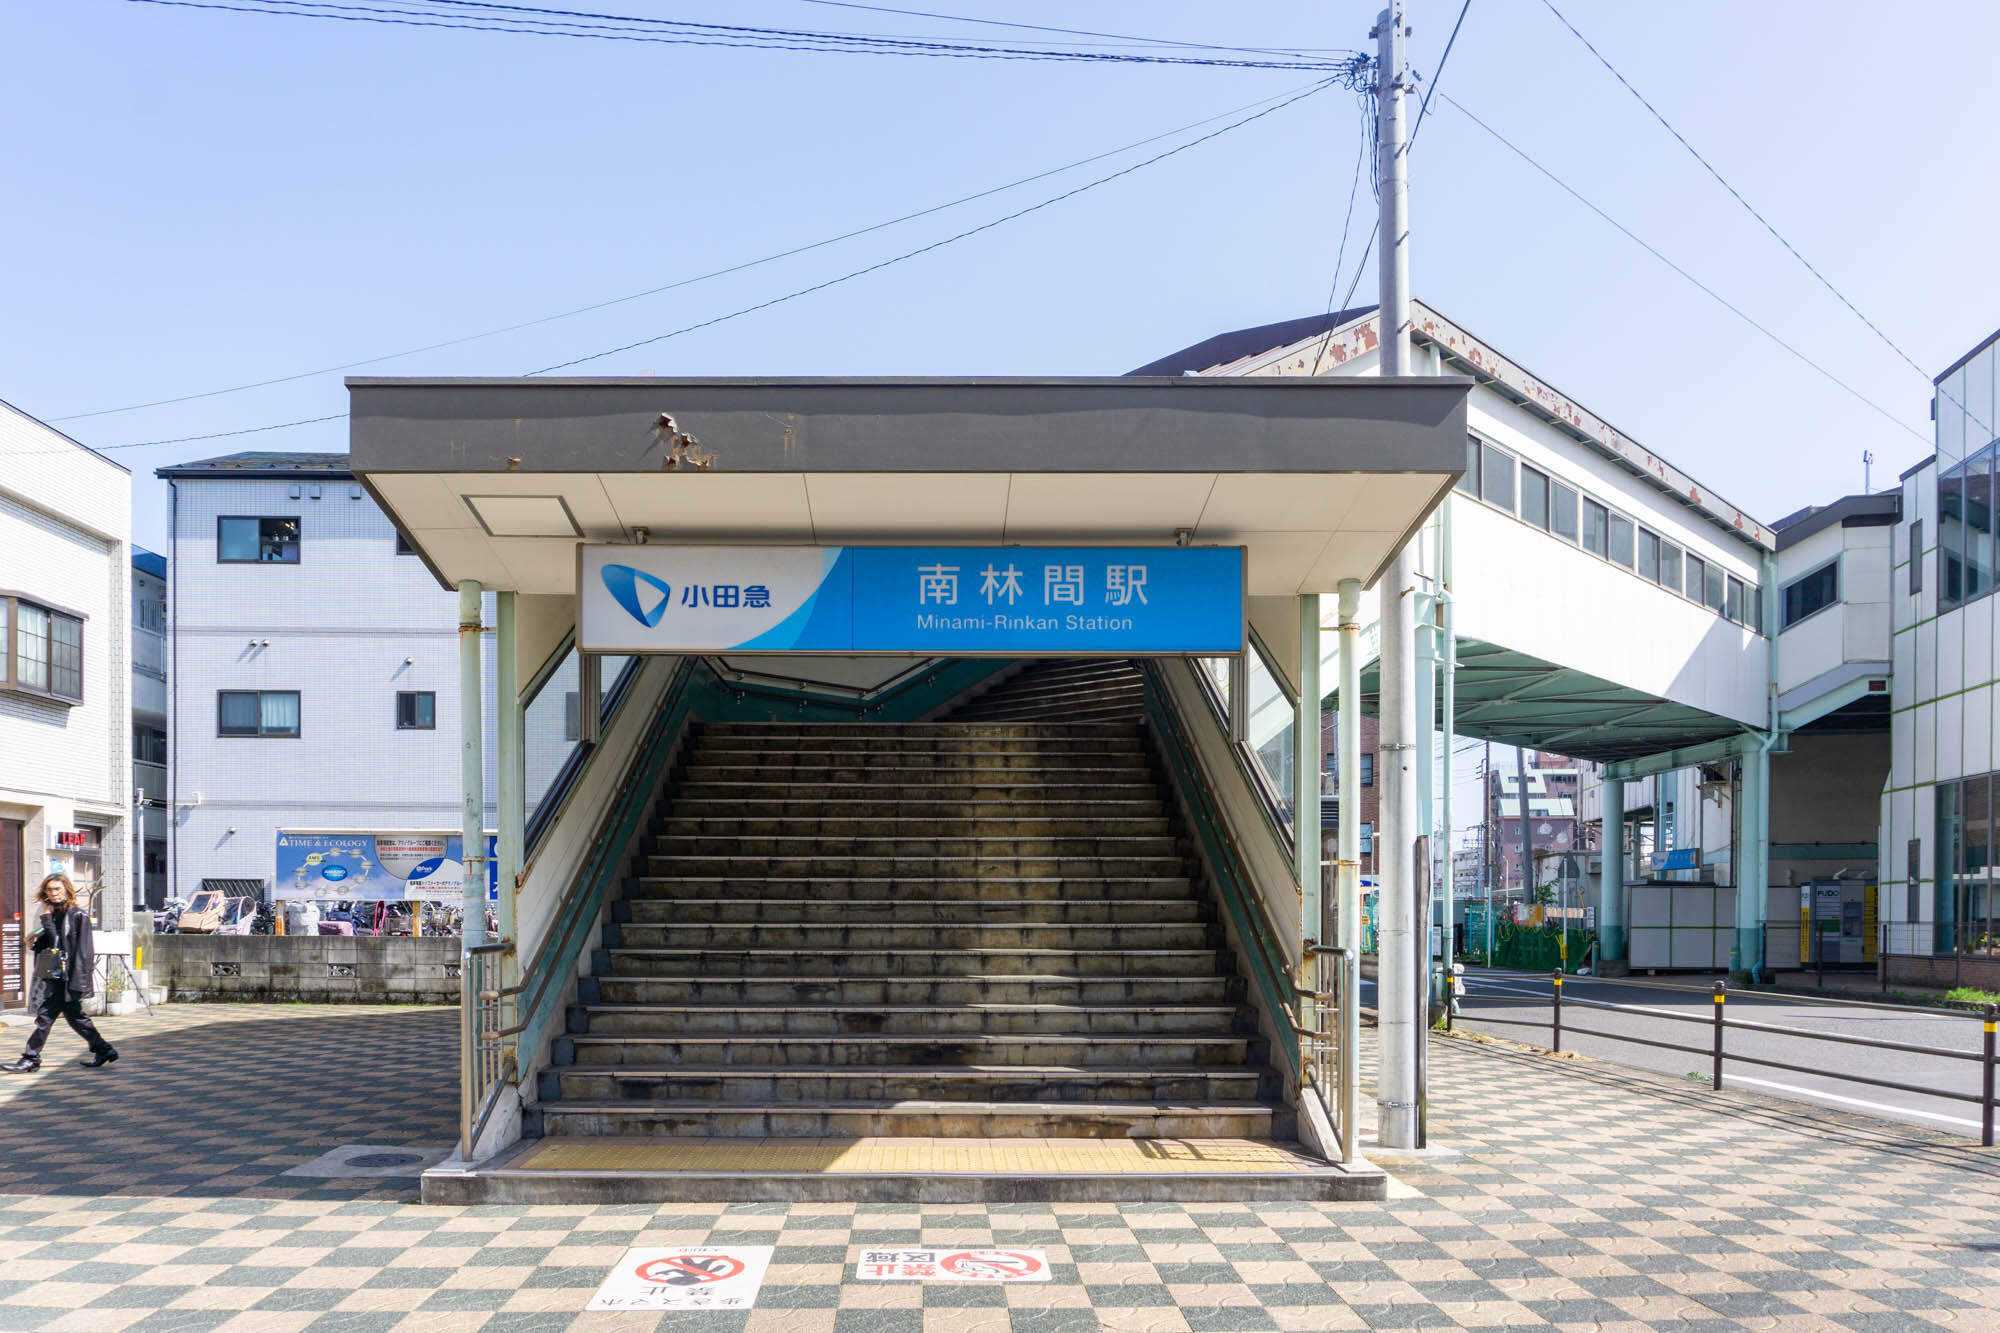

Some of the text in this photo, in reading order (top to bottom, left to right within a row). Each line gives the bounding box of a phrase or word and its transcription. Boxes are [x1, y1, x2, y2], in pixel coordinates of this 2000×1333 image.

[917, 563, 1148, 606] 南林間駅
[681, 585, 772, 609] 小田急
[917, 614, 1132, 631] Minami-Rinkan Station
[62, 831, 86, 845] LEAF
[287, 839, 312, 847] TIME
[323, 839, 368, 847] ECOLOGY
[865, 1252, 936, 1263] 区域
[863, 1263, 936, 1277] 禁止
[640, 1286, 713, 1296] 禁止
